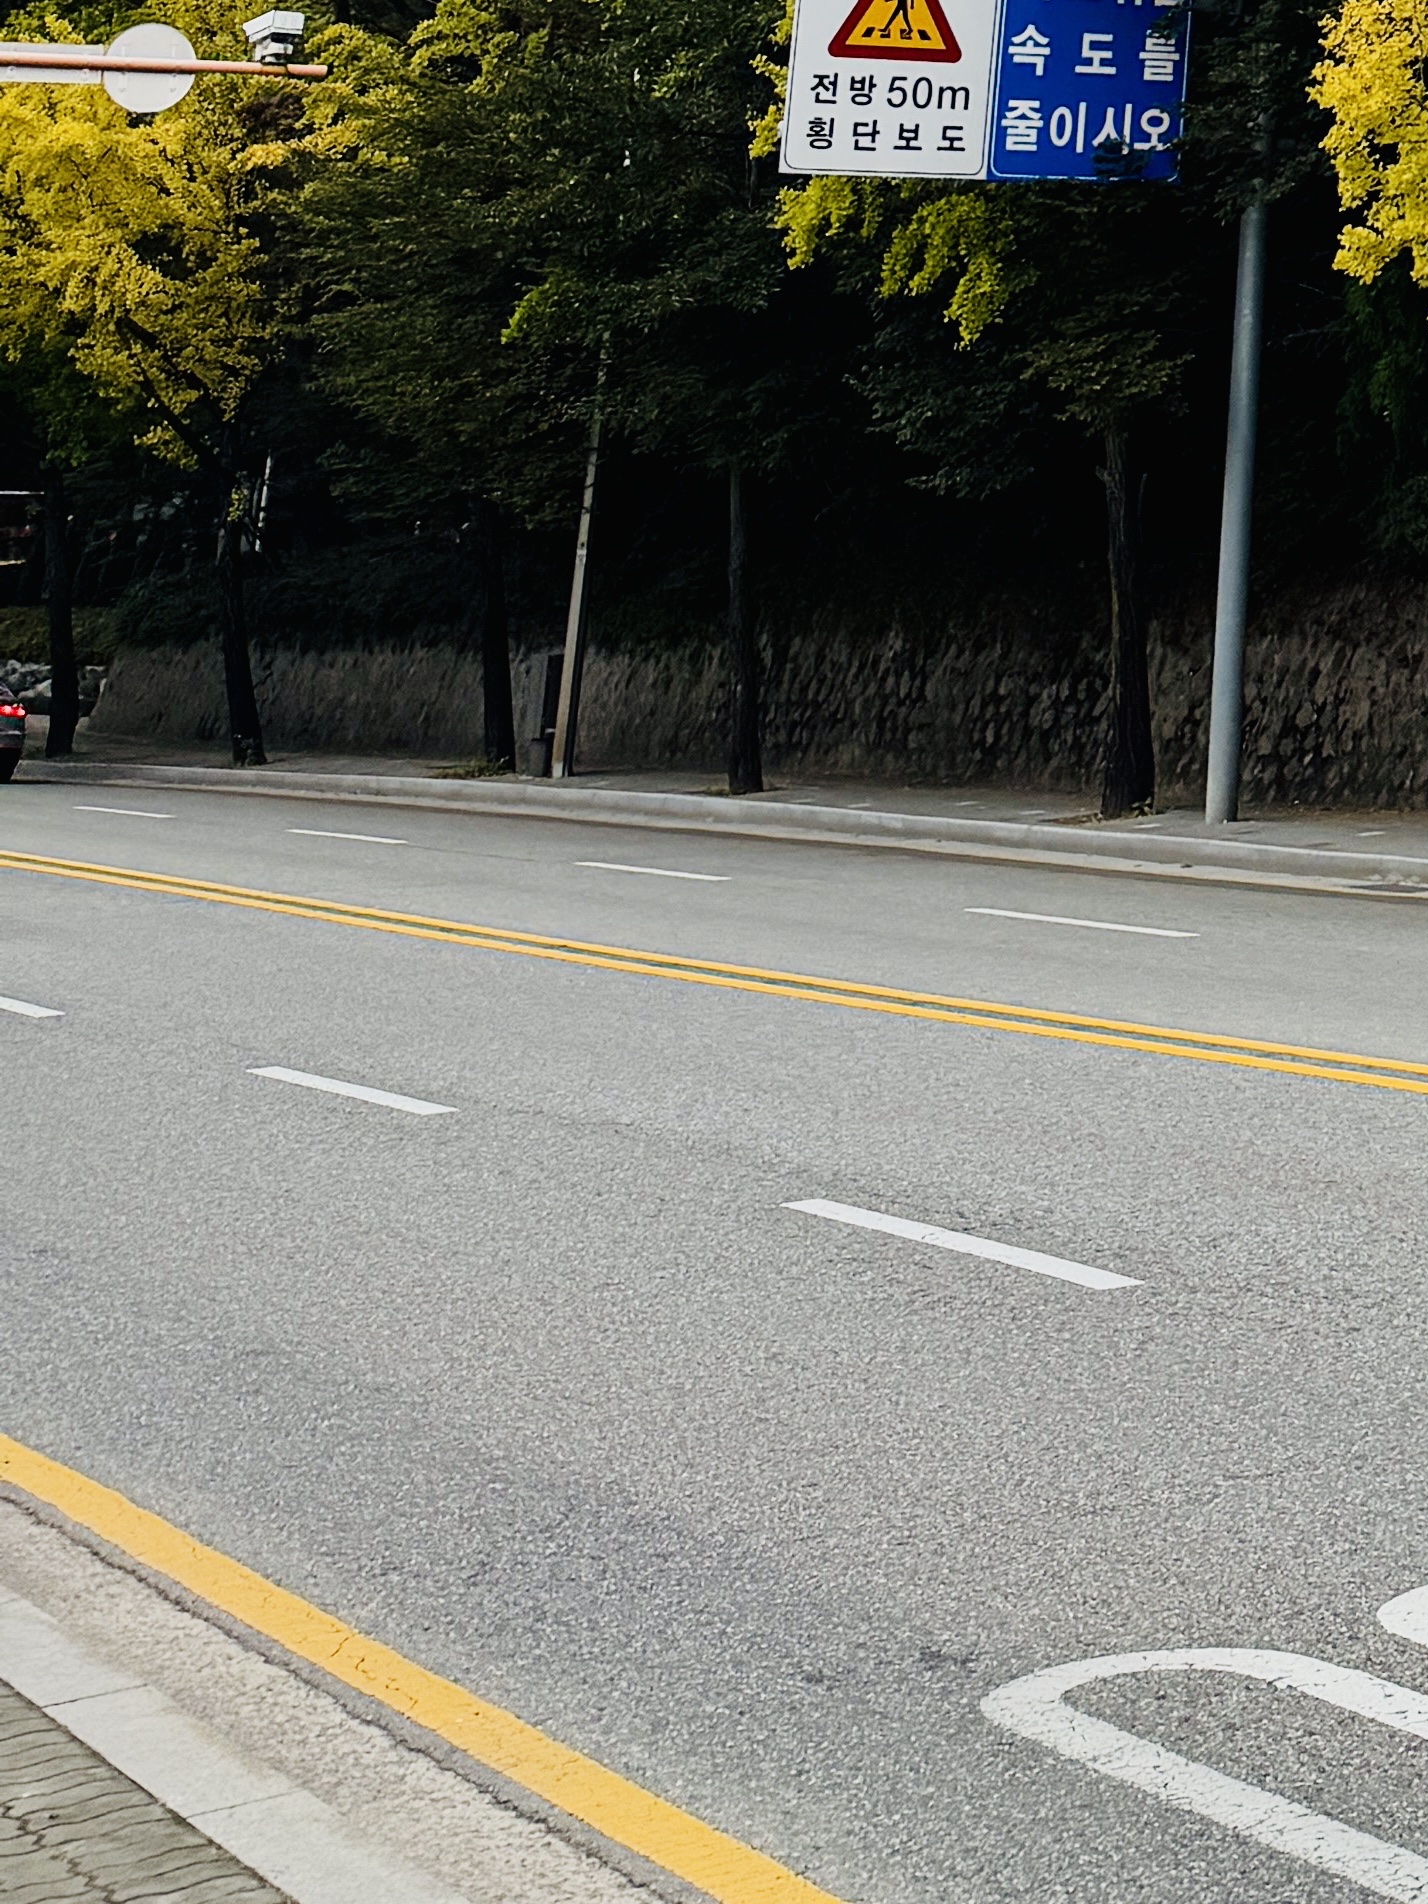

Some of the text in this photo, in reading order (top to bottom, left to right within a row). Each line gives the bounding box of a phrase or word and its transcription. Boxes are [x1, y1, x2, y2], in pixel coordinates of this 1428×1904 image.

[810, 72, 970, 111] 전방 50m
[806, 117, 966, 151] 횡단보도
[1001, 99, 1172, 155] 줄이시오
